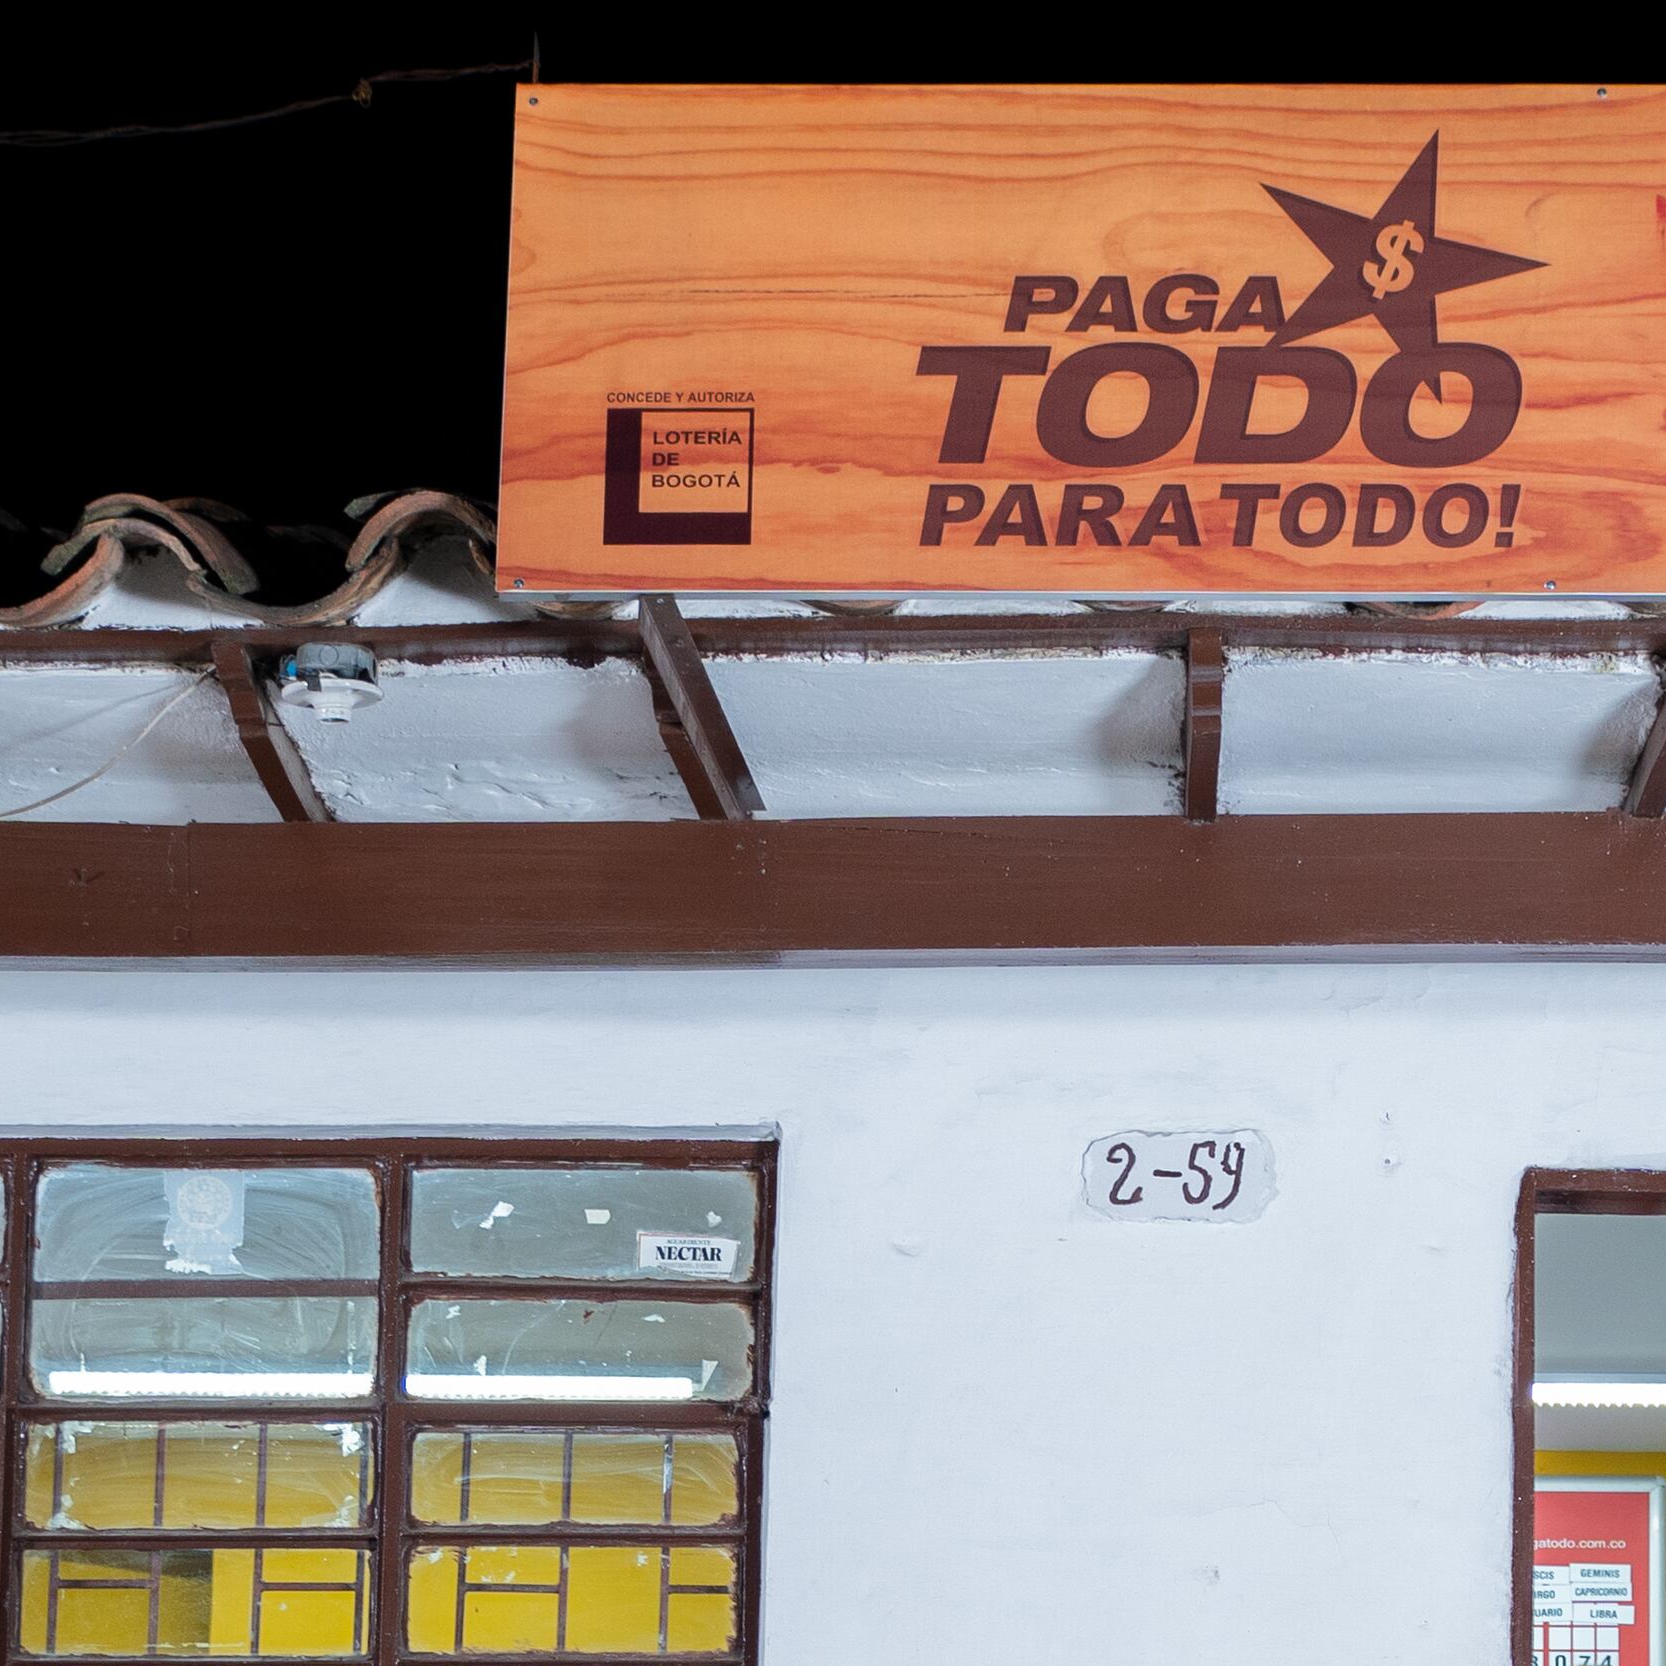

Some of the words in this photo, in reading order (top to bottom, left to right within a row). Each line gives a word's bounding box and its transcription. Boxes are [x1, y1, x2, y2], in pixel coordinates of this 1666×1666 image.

[1003, 273, 1287, 334] PAGA
[606, 391, 672, 403] CONCEDE
[675, 391, 684, 403] Y
[687, 391, 755, 403] AUTORIZA
[915, 341, 1523, 468] TODO
[652, 428, 742, 445] LOTERÍA
[652, 452, 680, 466] DE
[651, 471, 741, 488] BOGOTÁ
[919, 483, 1202, 548] PARA
[1219, 482, 1522, 549] TODO!
[1106, 1140, 1246, 1210] 2-59
[655, 1245, 723, 1262] NECTAR
[1533, 1538, 1627, 1550] gatodo.com.co
[1533, 1571, 1555, 1580] SCIS
[1580, 1568, 1621, 1579] GEMINIS
[1533, 1589, 1556, 1599] IRGO
[1574, 1587, 1628, 1597] CAPRICORNIO
[1533, 1607, 1564, 1618] UARIO
[1589, 1608, 1619, 1620] LIBRA
